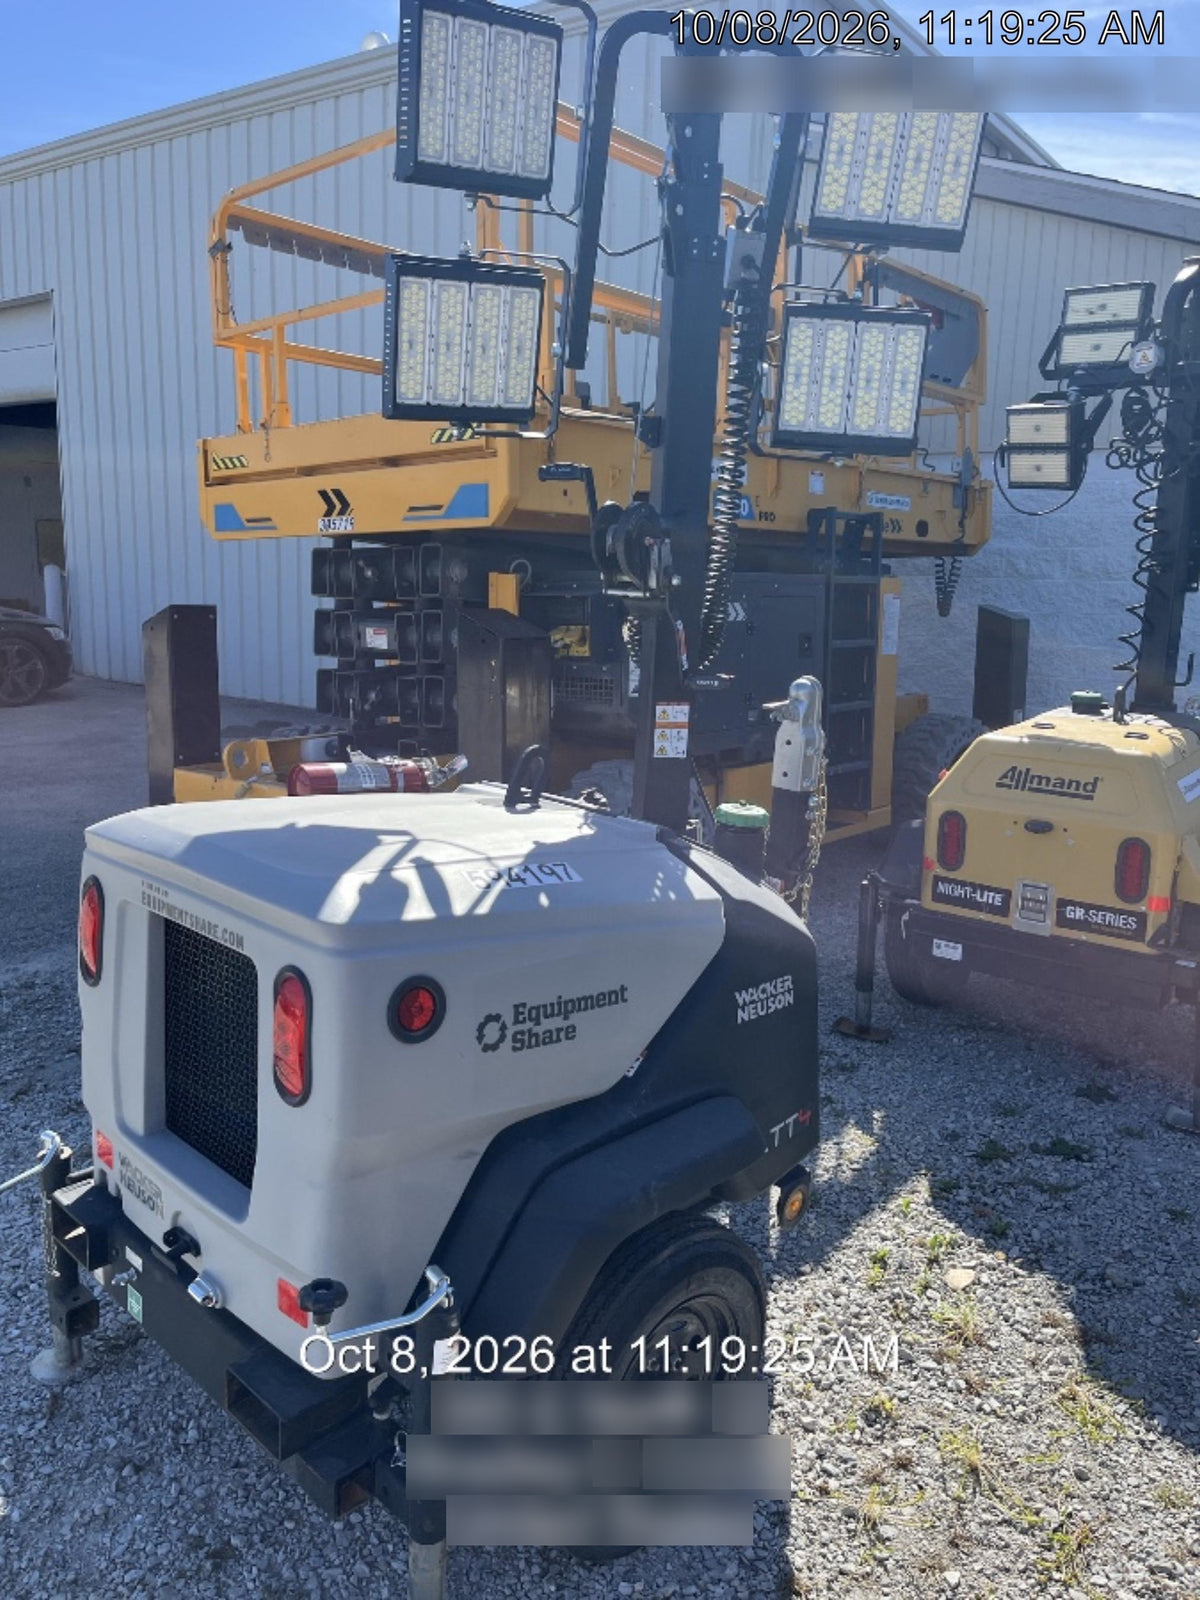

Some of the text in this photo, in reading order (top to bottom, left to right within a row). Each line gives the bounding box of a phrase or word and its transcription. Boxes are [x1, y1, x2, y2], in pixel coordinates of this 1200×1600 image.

[996, 765, 1100, 798] Allmand
[936, 880, 1003, 907] NIGHT-LITE
[141, 890, 245, 952] EQUIPMENTSHARE.COM
[1066, 904, 1138, 930] GR-SERIES
[512, 984, 629, 1027] Equipment
[734, 975, 794, 1007] WACKER
[737, 989, 794, 1024] NEUSON
[511, 1023, 577, 1052] Share
[120, 1169, 165, 1220] NEUSON
